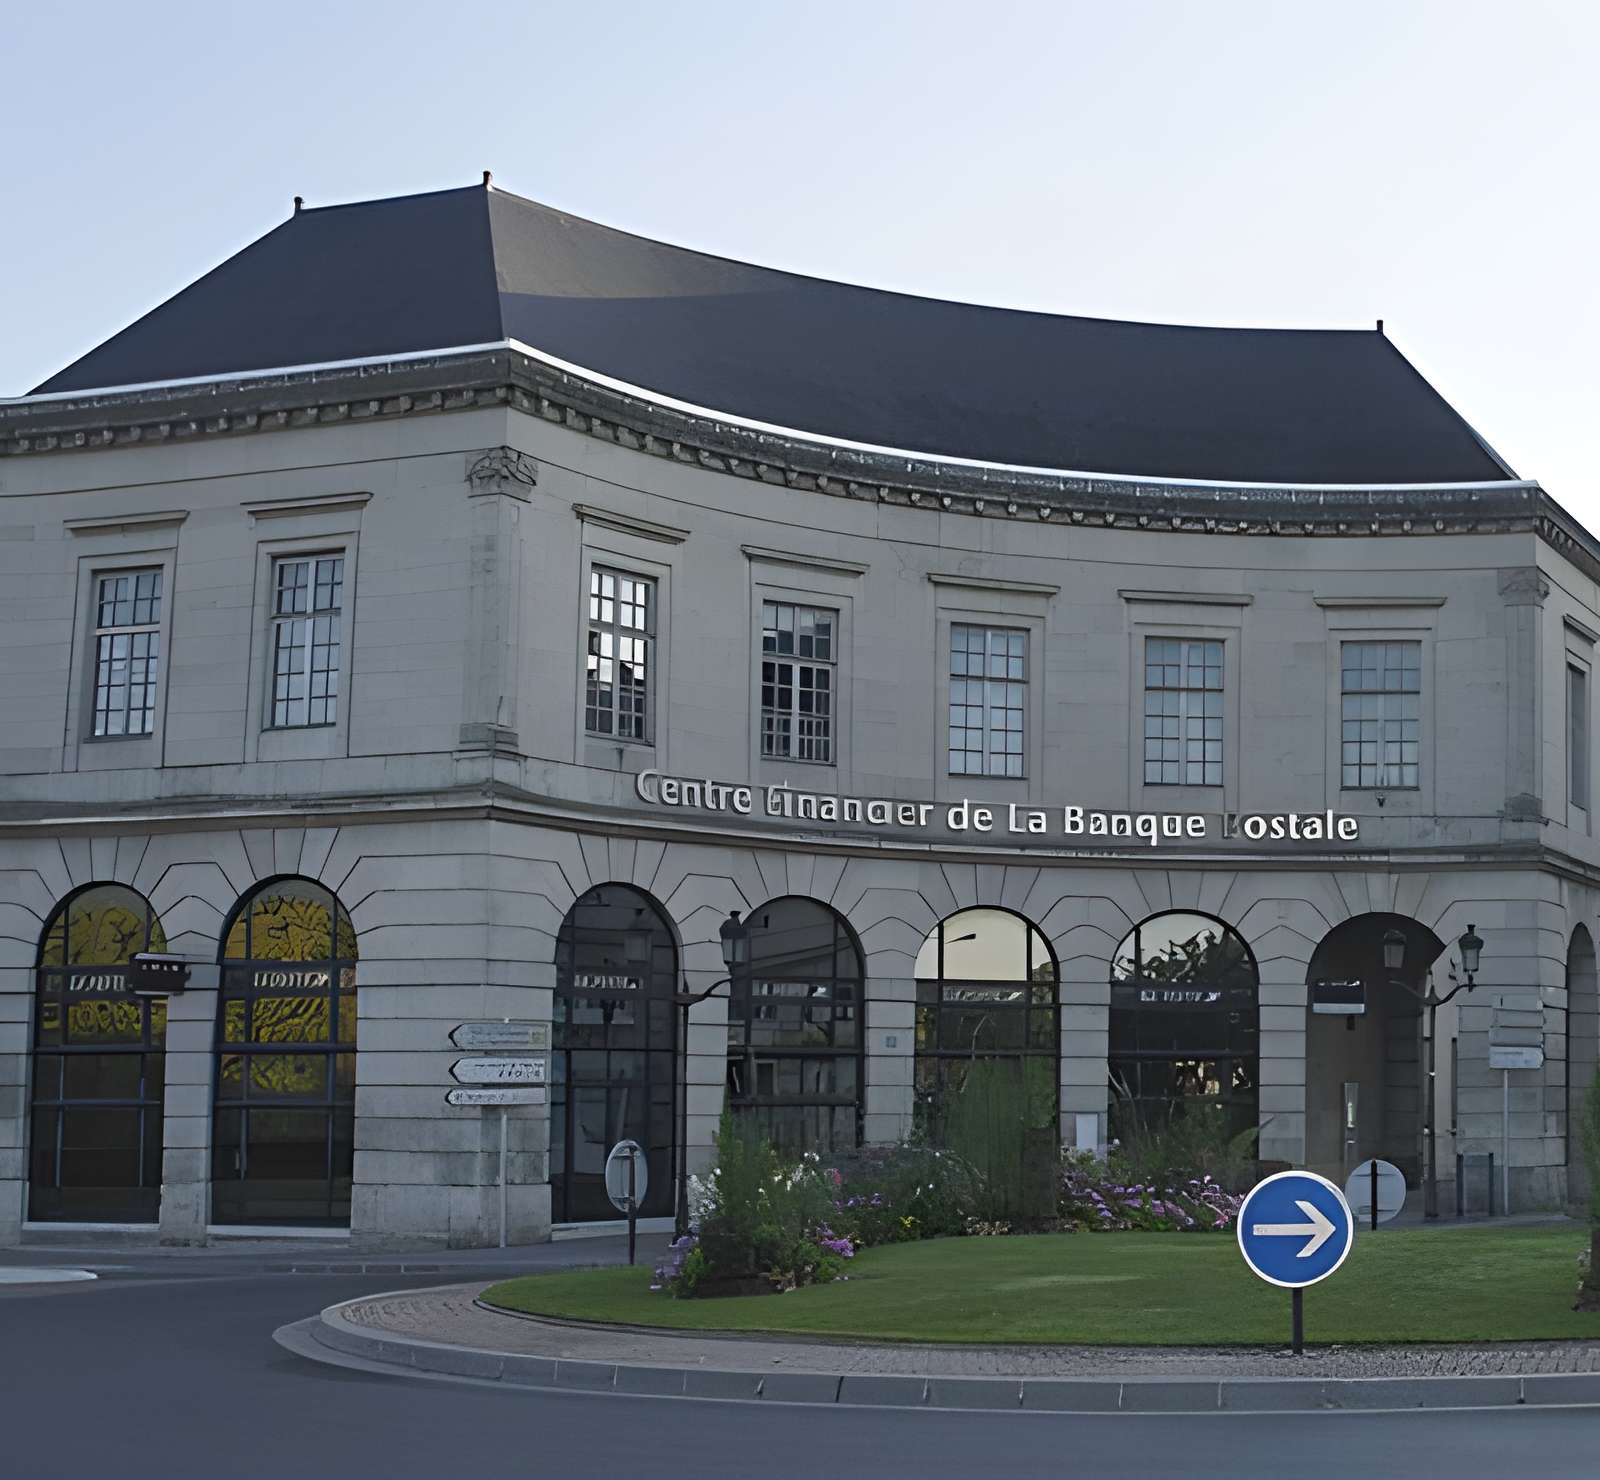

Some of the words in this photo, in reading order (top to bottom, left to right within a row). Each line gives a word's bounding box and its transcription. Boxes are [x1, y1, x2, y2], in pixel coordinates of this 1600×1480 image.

[636, 769, 752, 815] Centre
[947, 799, 993, 831] de
[1009, 803, 1047, 834] La
[1063, 805, 1206, 846] Banque
